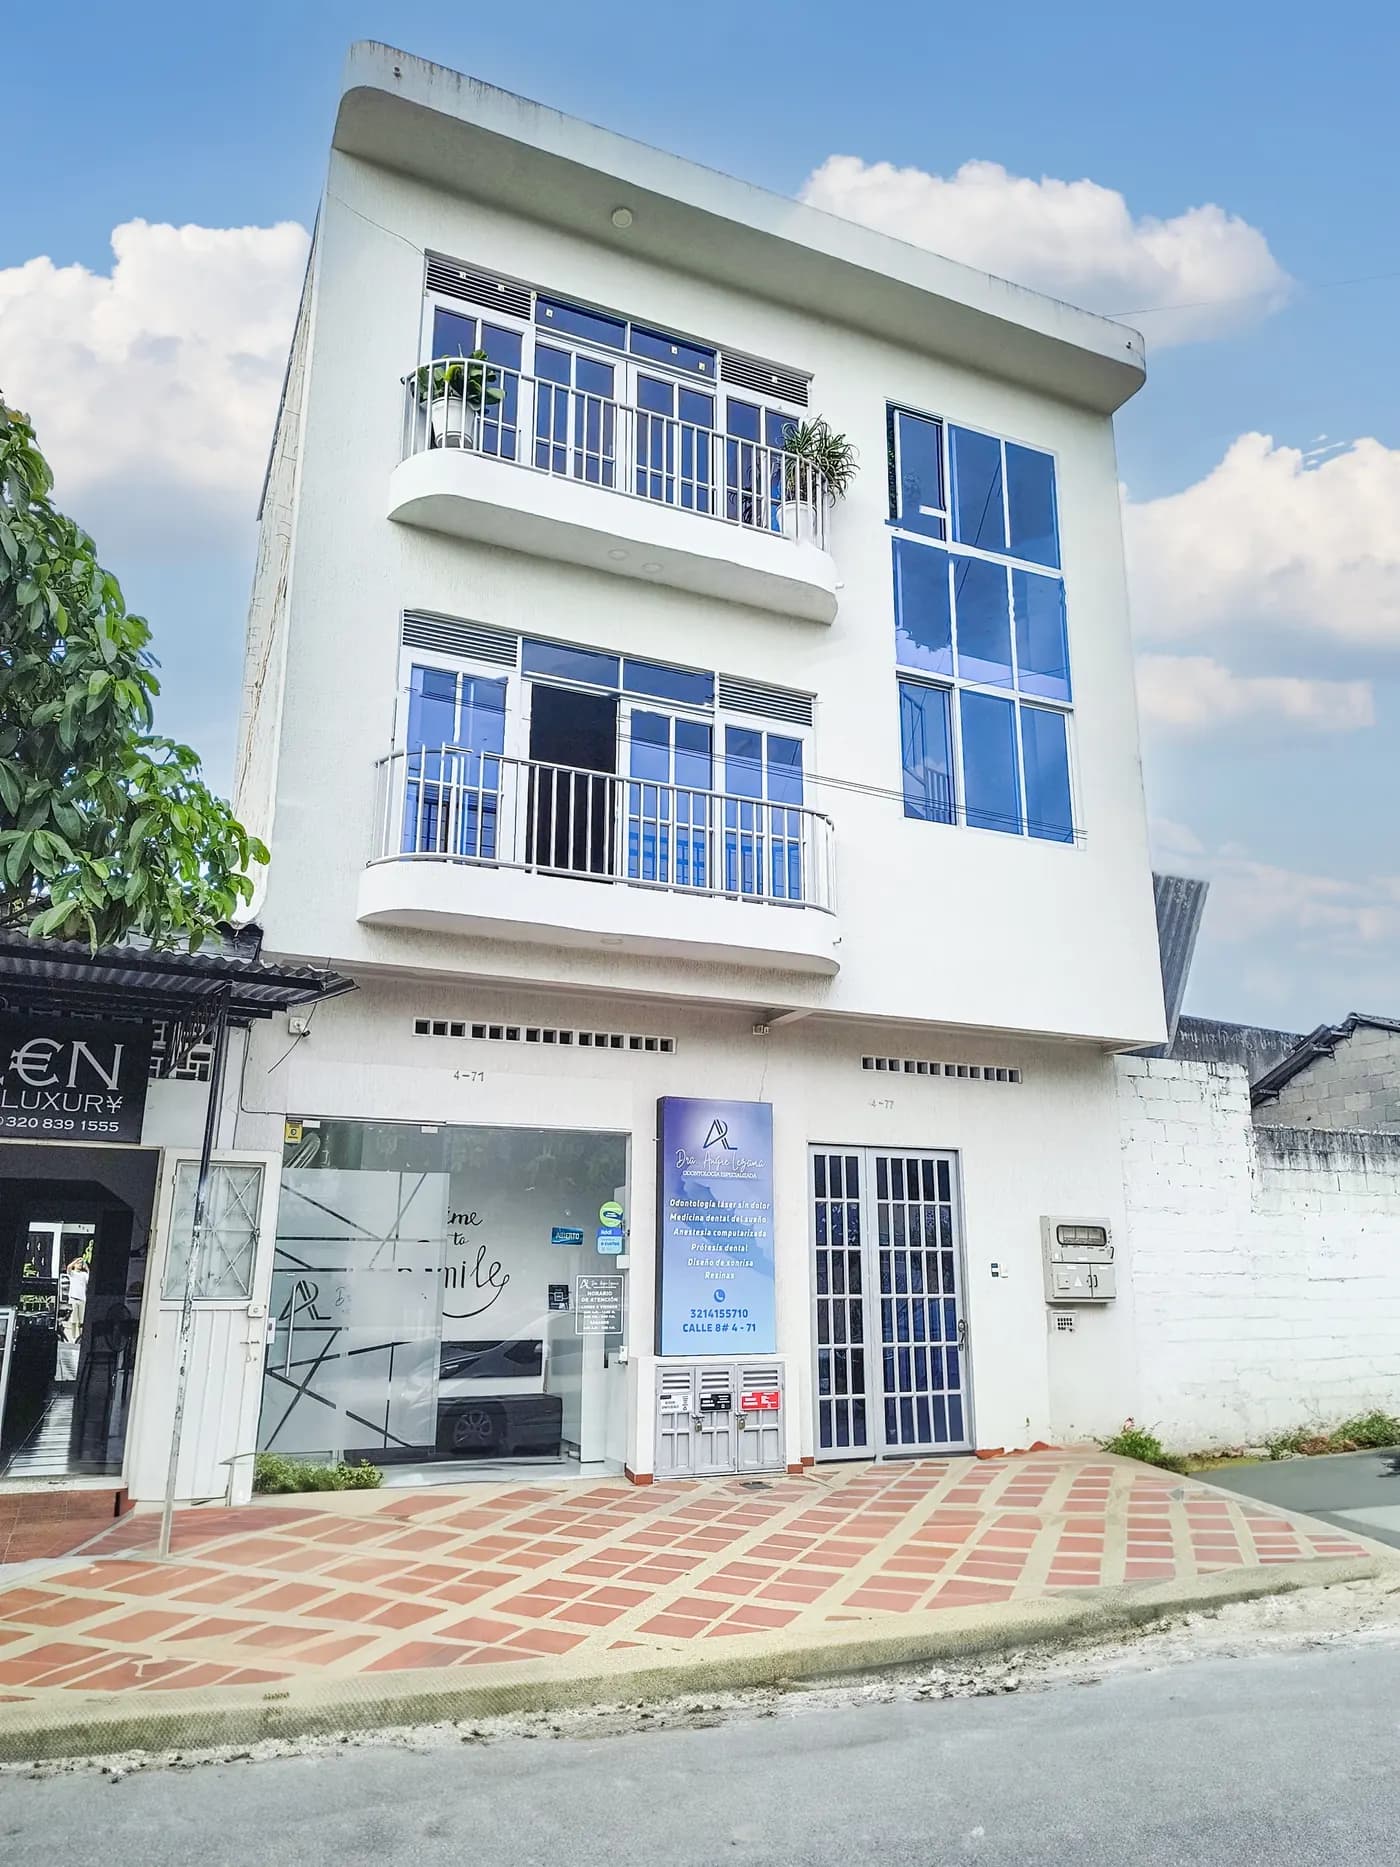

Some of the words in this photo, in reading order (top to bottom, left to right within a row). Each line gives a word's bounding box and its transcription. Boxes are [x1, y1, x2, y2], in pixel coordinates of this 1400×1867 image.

[453, 1069, 484, 1081] 4-71
[5, 1116, 38, 1128] 320
[42, 1118, 74, 1130] 839
[81, 1120, 119, 1132] 1555
[669, 1199, 716, 1209] Odontología
[737, 1201, 749, 1209] sin
[750, 1200, 770, 1210] dolor
[669, 1213, 704, 1222] Medicina
[705, 1214, 730, 1223] dental
[731, 1214, 742, 1223] del
[673, 1228, 712, 1236] Anestesia
[713, 1229, 767, 1238] computarizada
[447, 1231, 469, 1246] to
[691, 1243, 723, 1252] Prótesis
[724, 1244, 748, 1252] dental
[688, 1258, 714, 1266] Diseño
[724, 1259, 754, 1267] sonrisa
[704, 1271, 735, 1280] Resinas
[690, 1309, 749, 1319] 3214155710
[682, 1323, 713, 1333] CALLE
